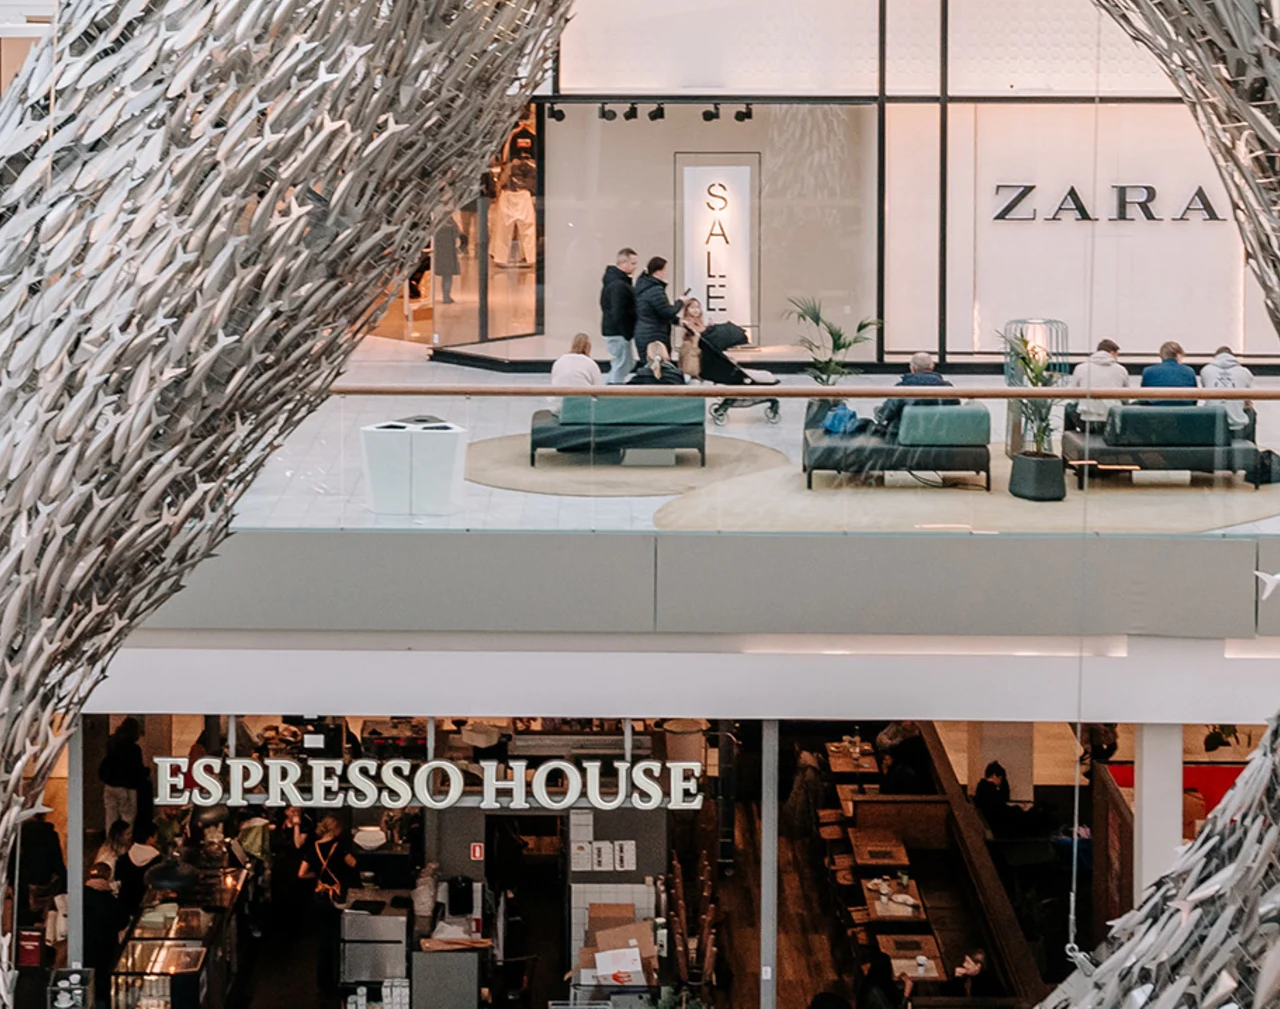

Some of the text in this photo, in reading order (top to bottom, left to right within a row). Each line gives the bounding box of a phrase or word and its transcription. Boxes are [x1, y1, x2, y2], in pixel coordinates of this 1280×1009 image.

[993, 185, 1227, 221] ZARA
[705, 183, 730, 311] SALE
[153, 756, 704, 810] ESPRESSO HOUSE
